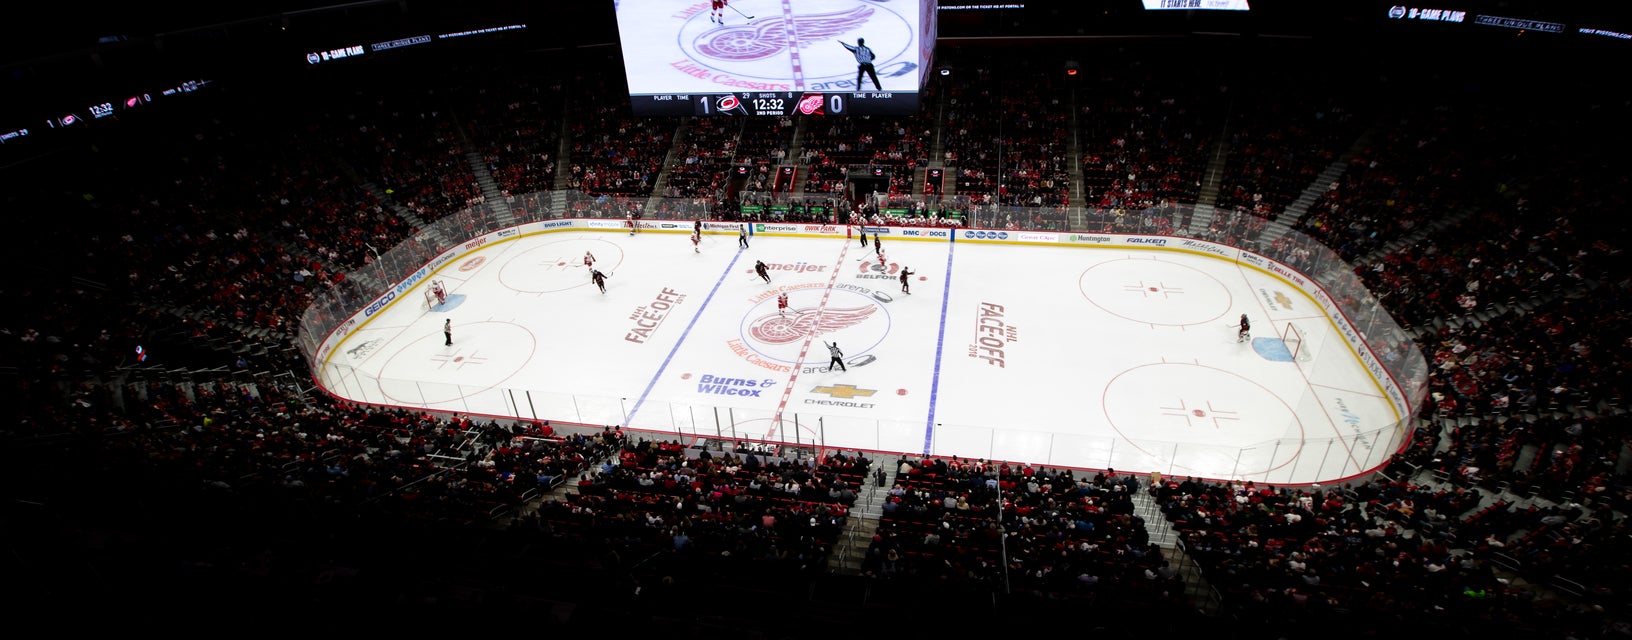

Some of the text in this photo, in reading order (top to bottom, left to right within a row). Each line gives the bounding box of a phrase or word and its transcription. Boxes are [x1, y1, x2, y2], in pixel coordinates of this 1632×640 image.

[670, 59, 711, 79] Little
[712, 74, 791, 91] Caesars
[89, 103, 114, 115] 12:32
[700, 96, 709, 114] 1
[752, 98, 785, 111] 12:32
[830, 94, 843, 114] 0
[465, 237, 487, 250] meijer
[1077, 235, 1111, 243] Huntington
[767, 262, 827, 273] meijer
[1273, 266, 1305, 286] BELLE TIRE
[748, 282, 871, 304] Little Caesars arena
[364, 291, 396, 317] GEICO
[629, 305, 647, 321] NHL
[1006, 325, 1017, 342] NHL
[726, 338, 749, 358] Little
[745, 353, 792, 373] Caesars
[699, 374, 778, 388] Burns &
[697, 384, 762, 398] Wilcox
[804, 399, 876, 408] CHEVROLET
